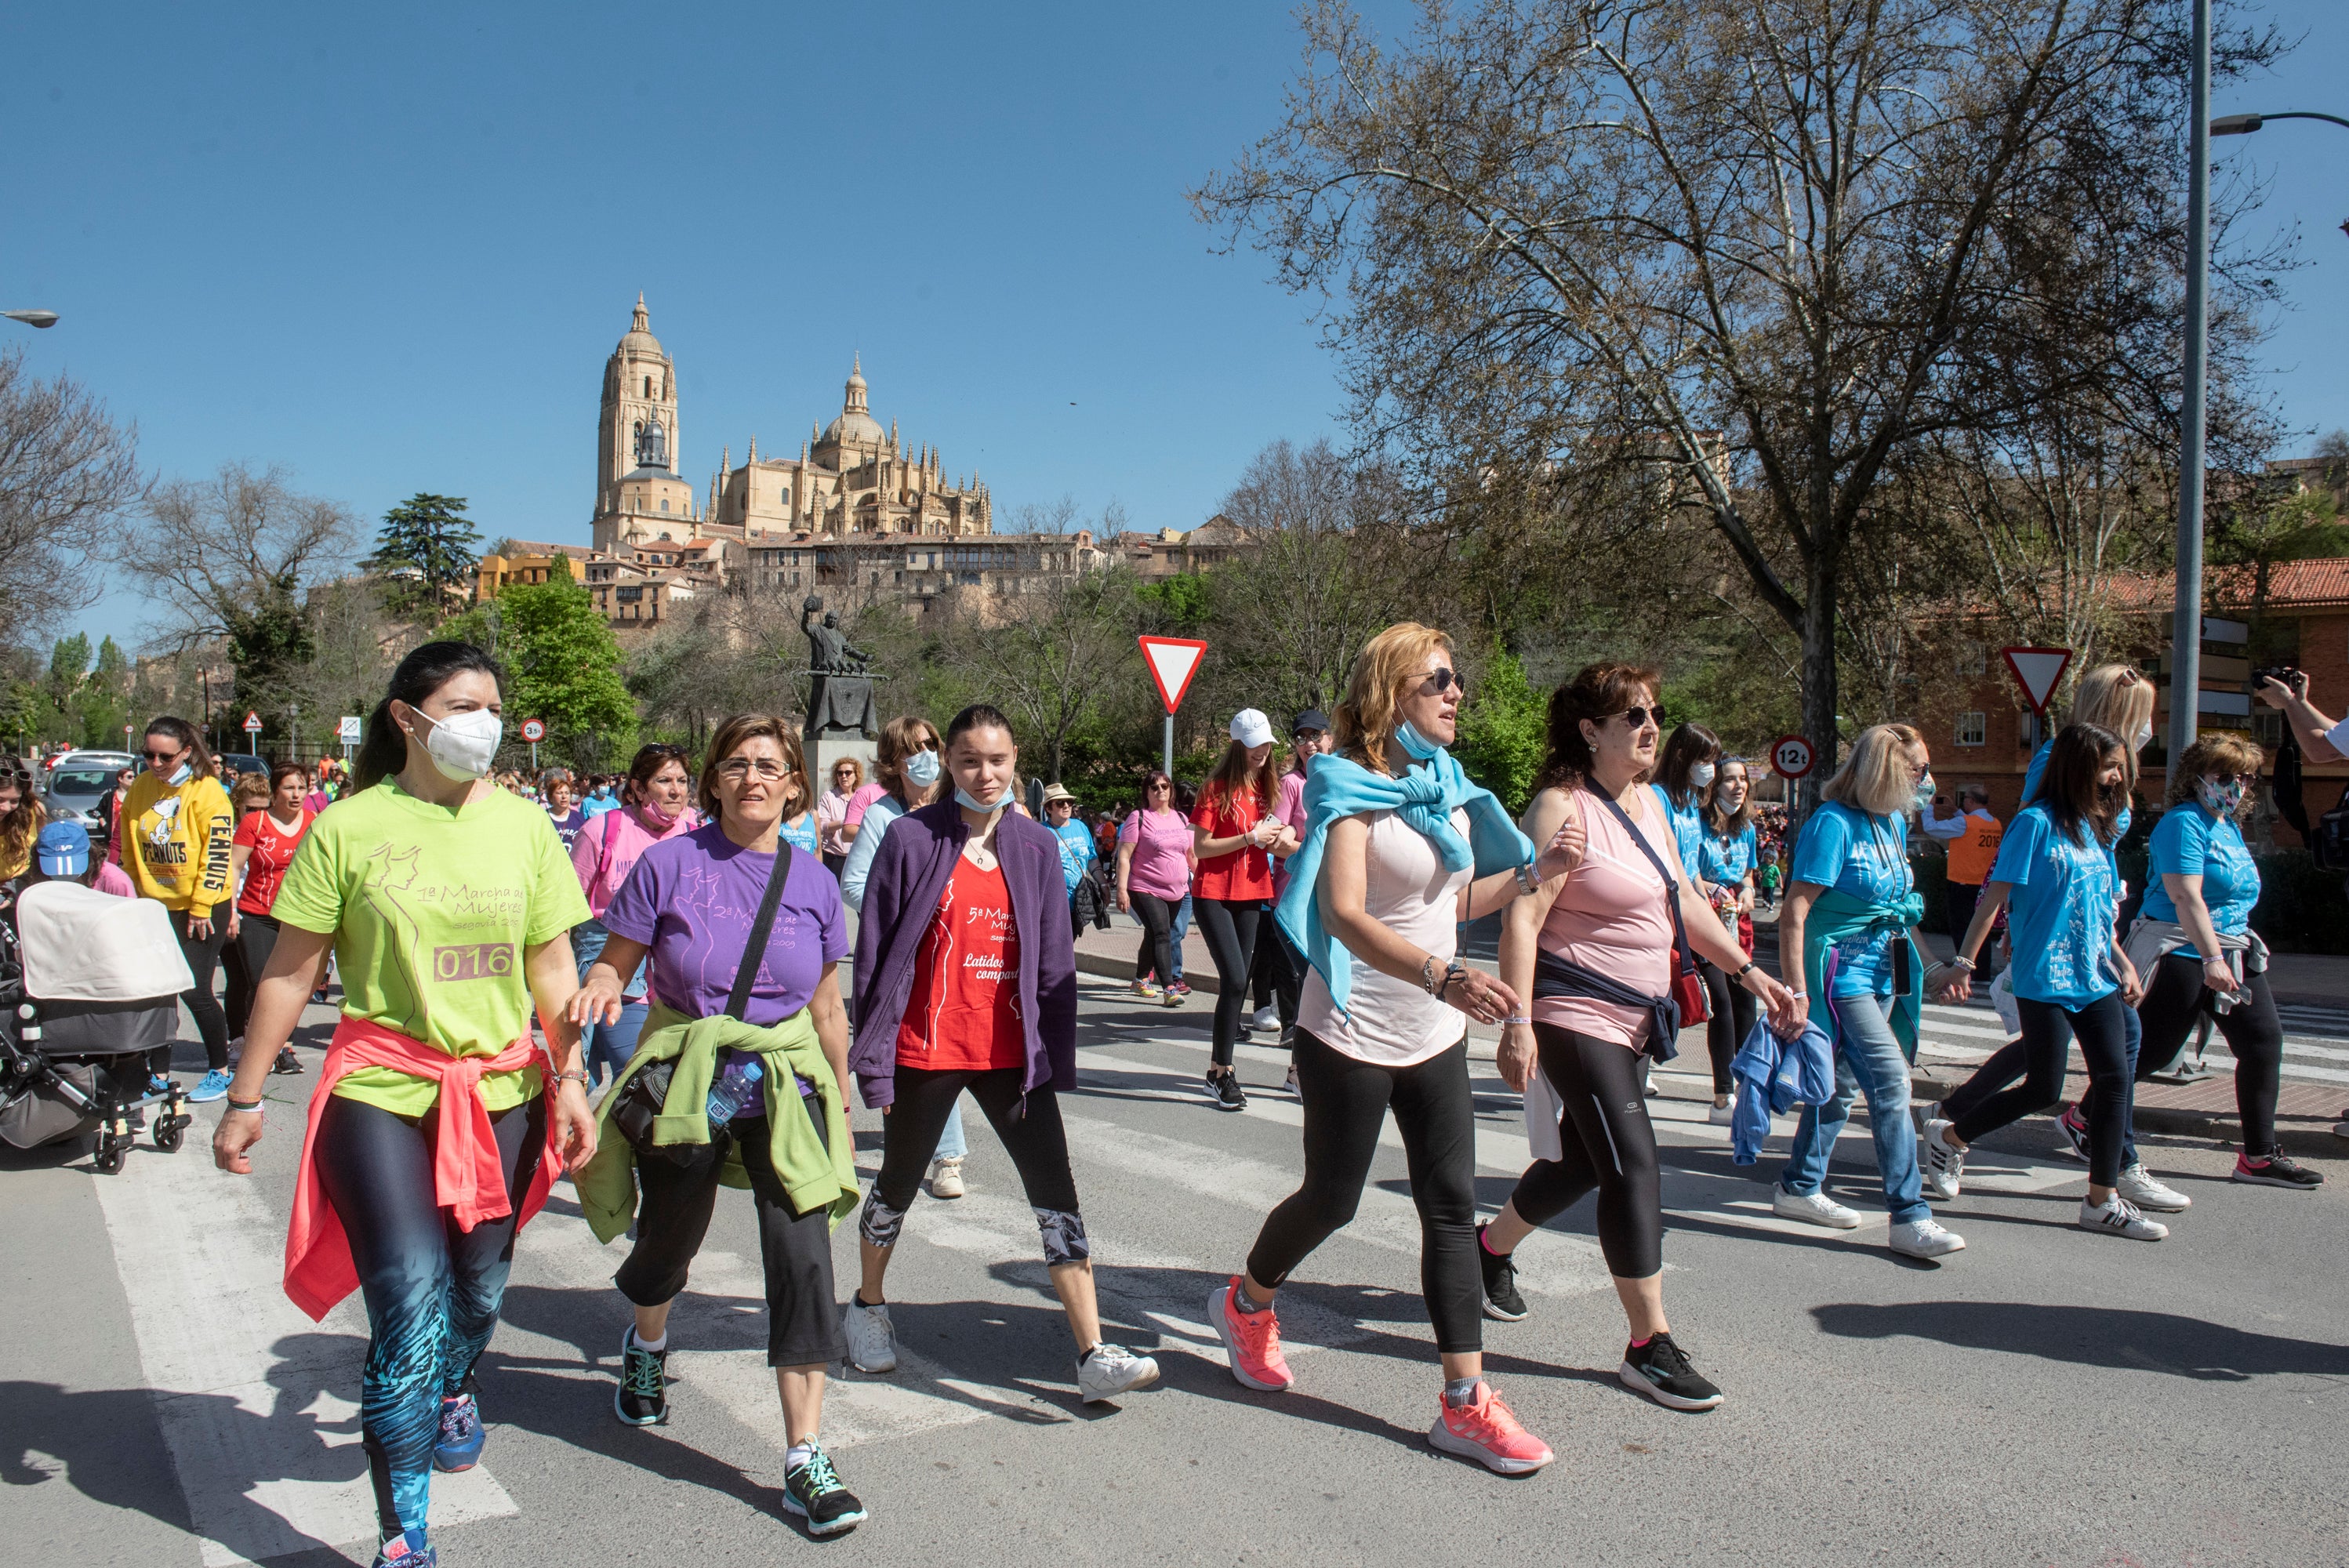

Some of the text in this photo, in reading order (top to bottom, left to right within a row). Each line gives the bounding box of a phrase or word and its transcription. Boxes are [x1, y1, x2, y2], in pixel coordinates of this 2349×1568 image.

[143, 842, 187, 864] PEANUTS
[204, 815, 232, 892] PEANUTS
[441, 884, 510, 902] Marcha
[454, 898, 522, 919] Mujeres
[785, 915, 797, 924] de
[772, 940, 796, 949] 2009
[437, 946, 511, 978] 016
[963, 953, 1004, 968] Latidos
[975, 969, 1018, 985] compart
